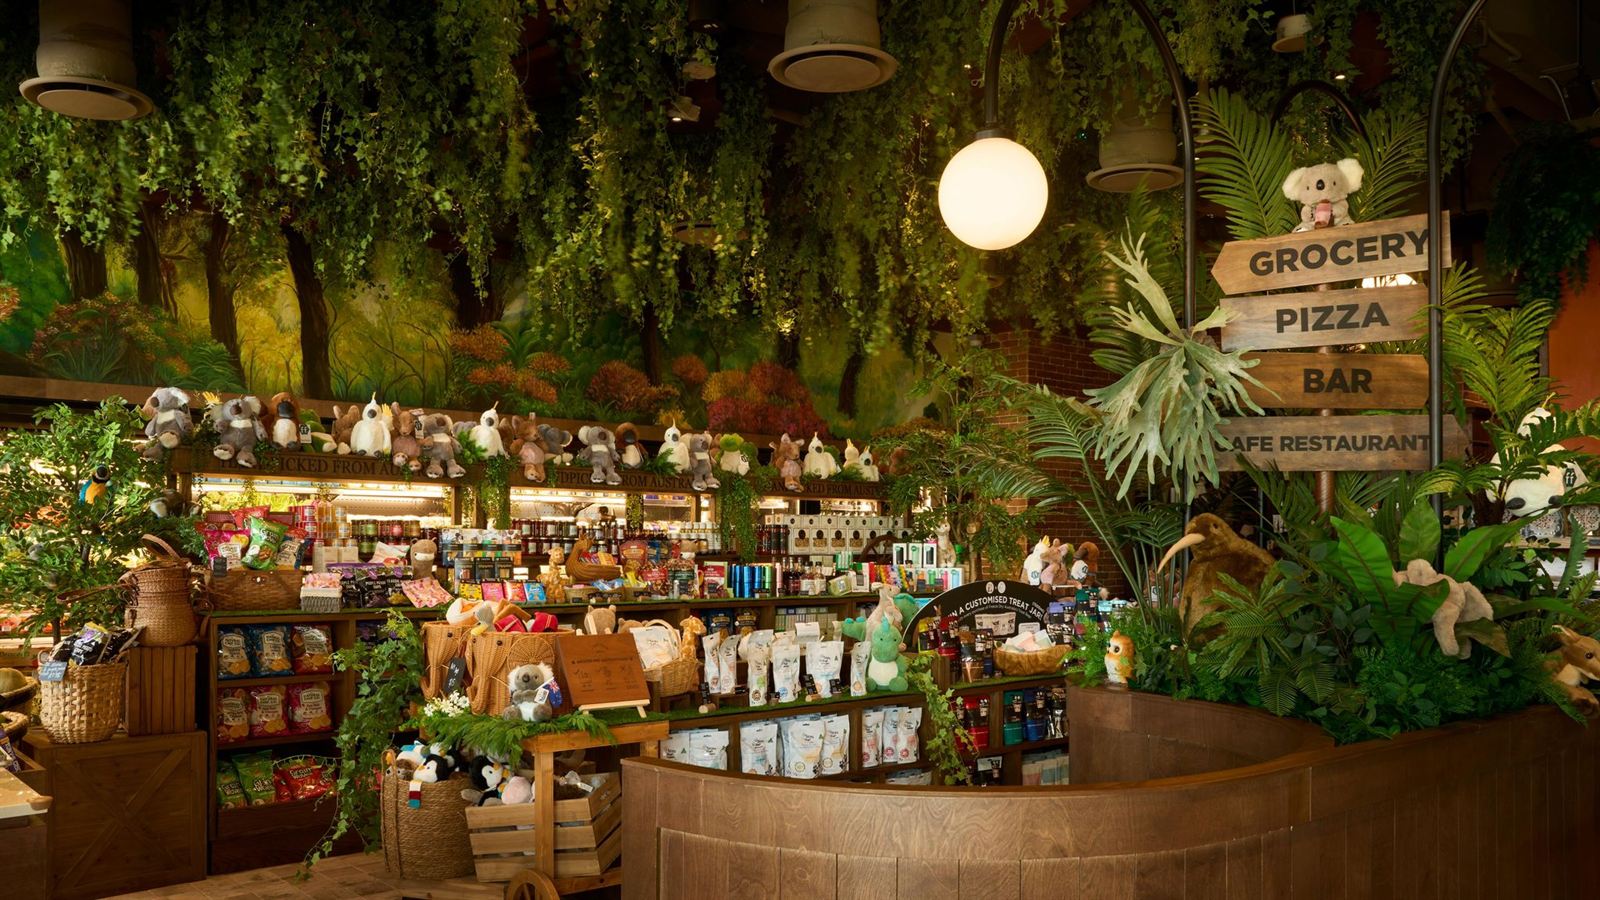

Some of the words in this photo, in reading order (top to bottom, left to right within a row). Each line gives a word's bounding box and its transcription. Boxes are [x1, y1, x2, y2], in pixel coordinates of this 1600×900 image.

[1249, 228, 1429, 277] GROCERY
[1276, 302, 1389, 333] PIZZA
[1303, 368, 1372, 394] BAR
[1280, 434, 1430, 452] RESTAURANT
[332, 459, 375, 475] FROM
[620, 474, 647, 488] ROM
[650, 475, 693, 489] AUSTRA
[959, 606, 964, 615] A
[965, 596, 1008, 611] CUSTOMISED
[1009, 597, 1030, 610] TREAT
